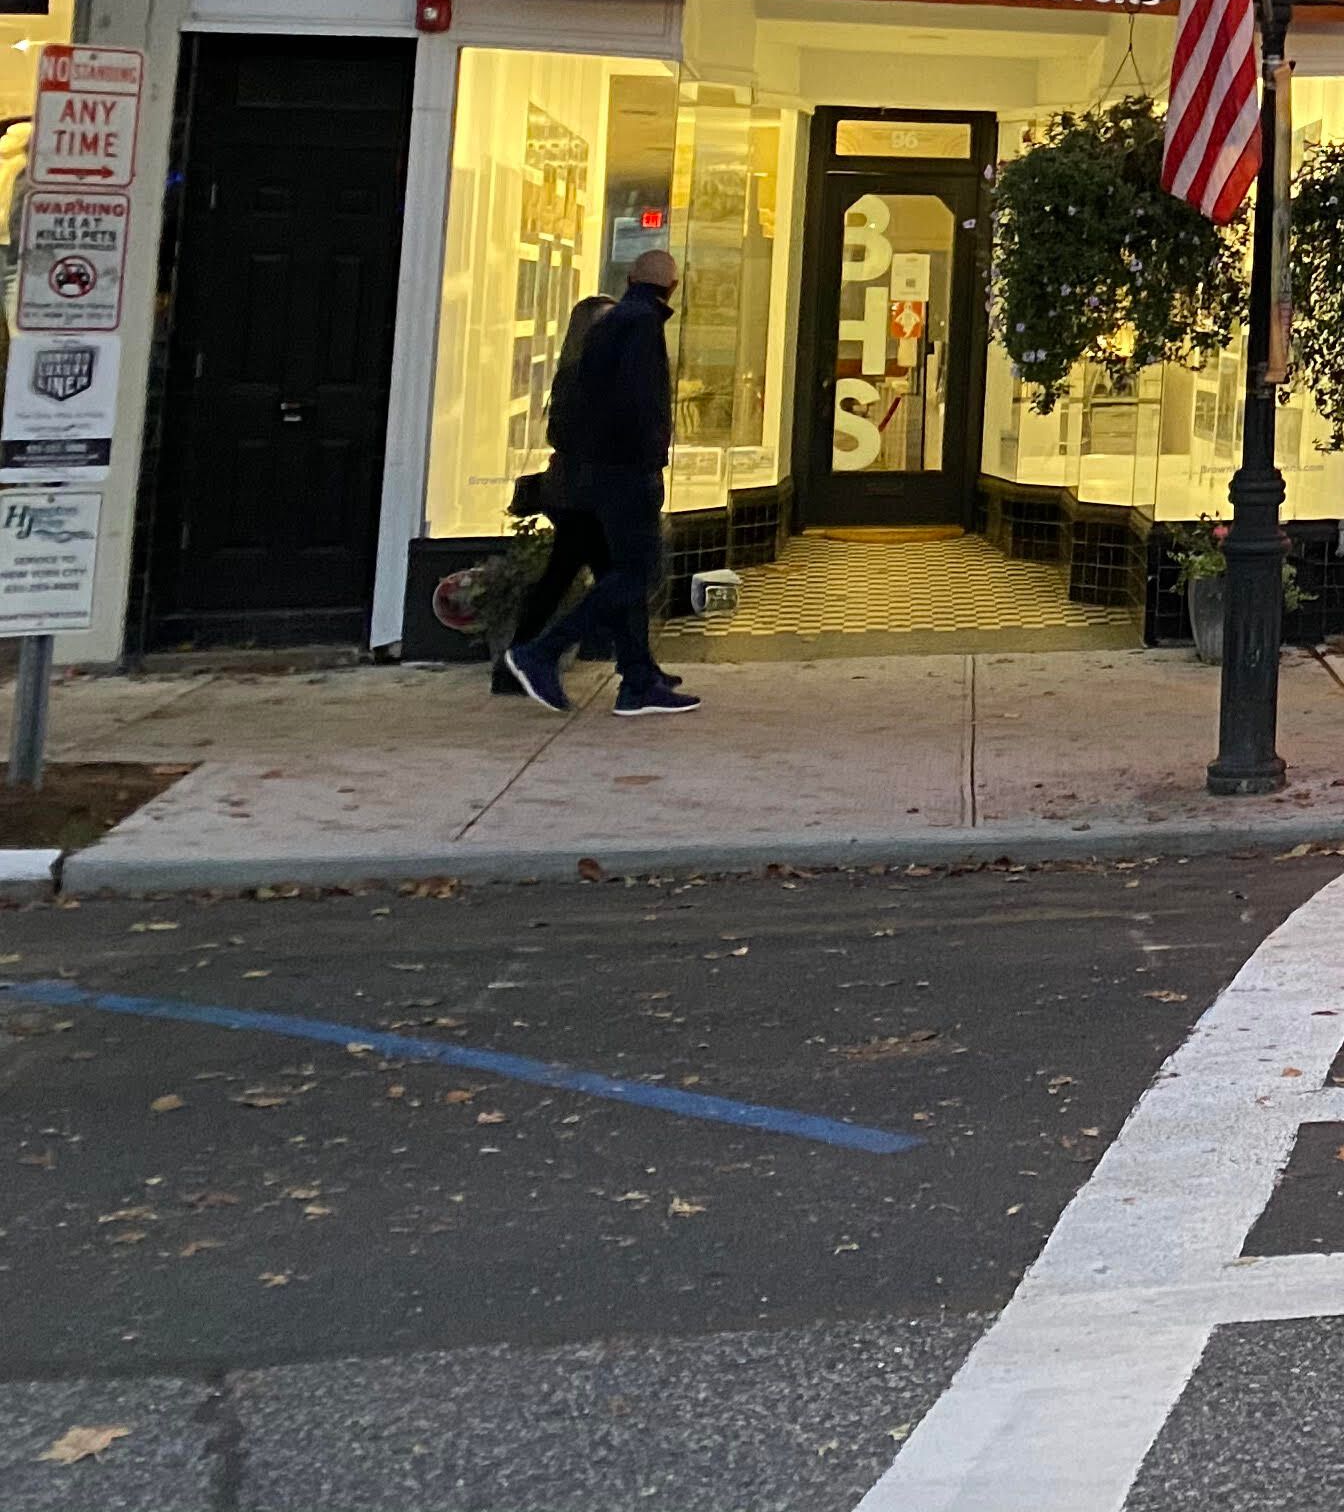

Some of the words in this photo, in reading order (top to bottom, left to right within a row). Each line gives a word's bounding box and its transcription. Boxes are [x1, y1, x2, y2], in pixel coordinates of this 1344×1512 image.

[40, 55, 70, 83] NO
[60, 98, 117, 125] ANY
[52, 129, 118, 158] TIME
[33, 201, 125, 217] WARNING
[54, 217, 103, 228] HEAT
[36, 230, 77, 241] KILLS
[81, 230, 117, 242] PETS
